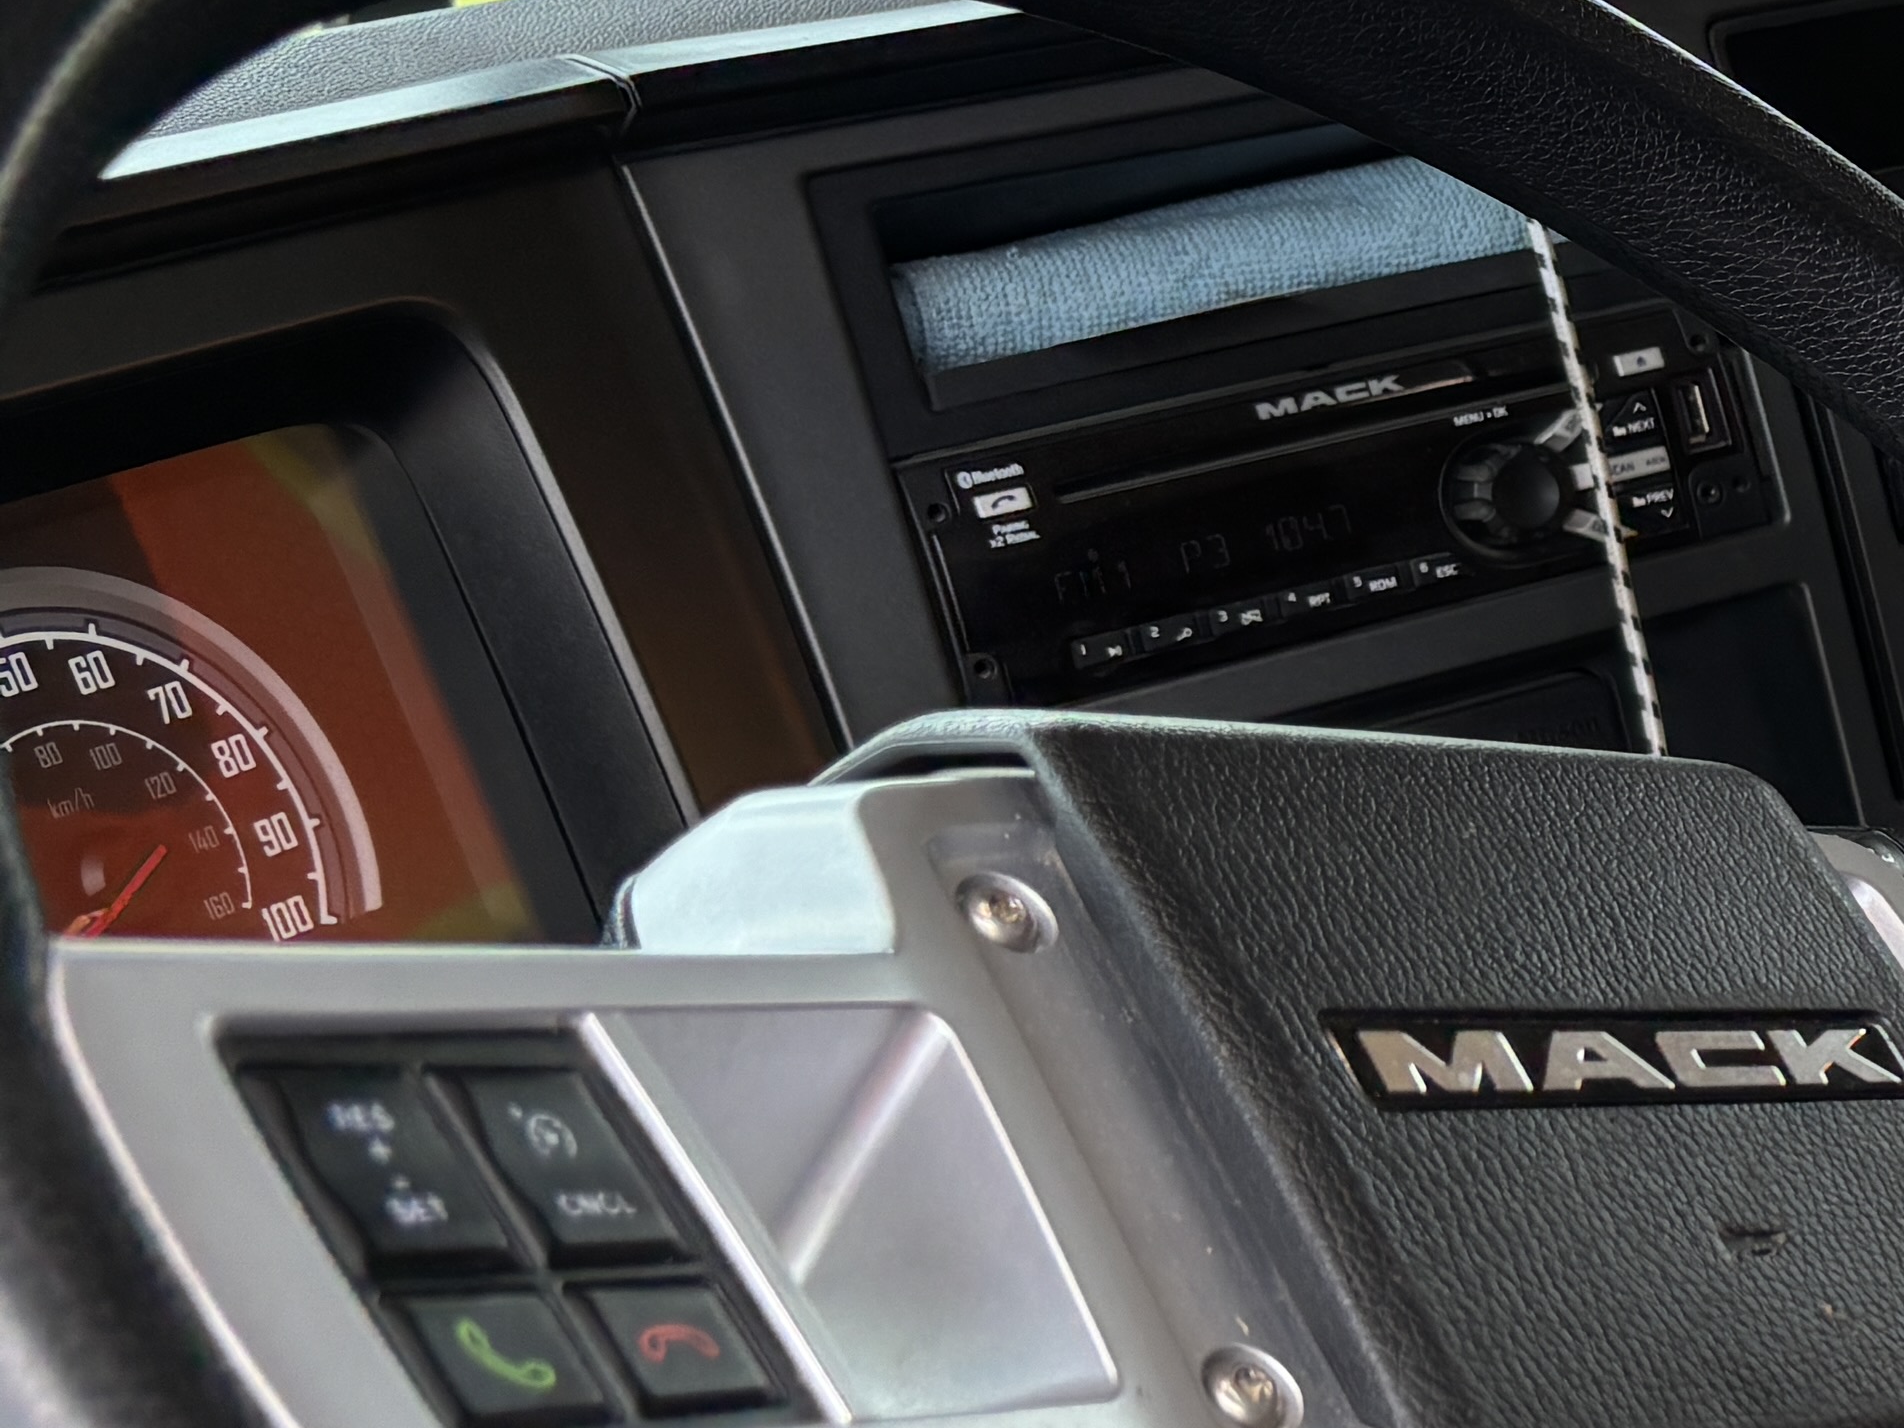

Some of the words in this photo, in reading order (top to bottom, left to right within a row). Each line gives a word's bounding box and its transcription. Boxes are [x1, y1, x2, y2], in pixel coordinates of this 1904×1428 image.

[1254, 373, 1407, 423] MACK
[1627, 417, 1655, 435] NEXT
[68, 651, 115, 695] 60
[147, 681, 193, 725] 70
[34, 742, 63, 769] 80
[88, 742, 122, 771] 100
[210, 734, 256, 778] 80
[47, 787, 95, 820] km/h
[144, 771, 177, 800] 120
[188, 824, 219, 852] 140
[252, 812, 299, 857] 90
[203, 892, 234, 920] 160
[260, 894, 315, 942] 100
[1357, 1029, 1902, 1092] MACK
